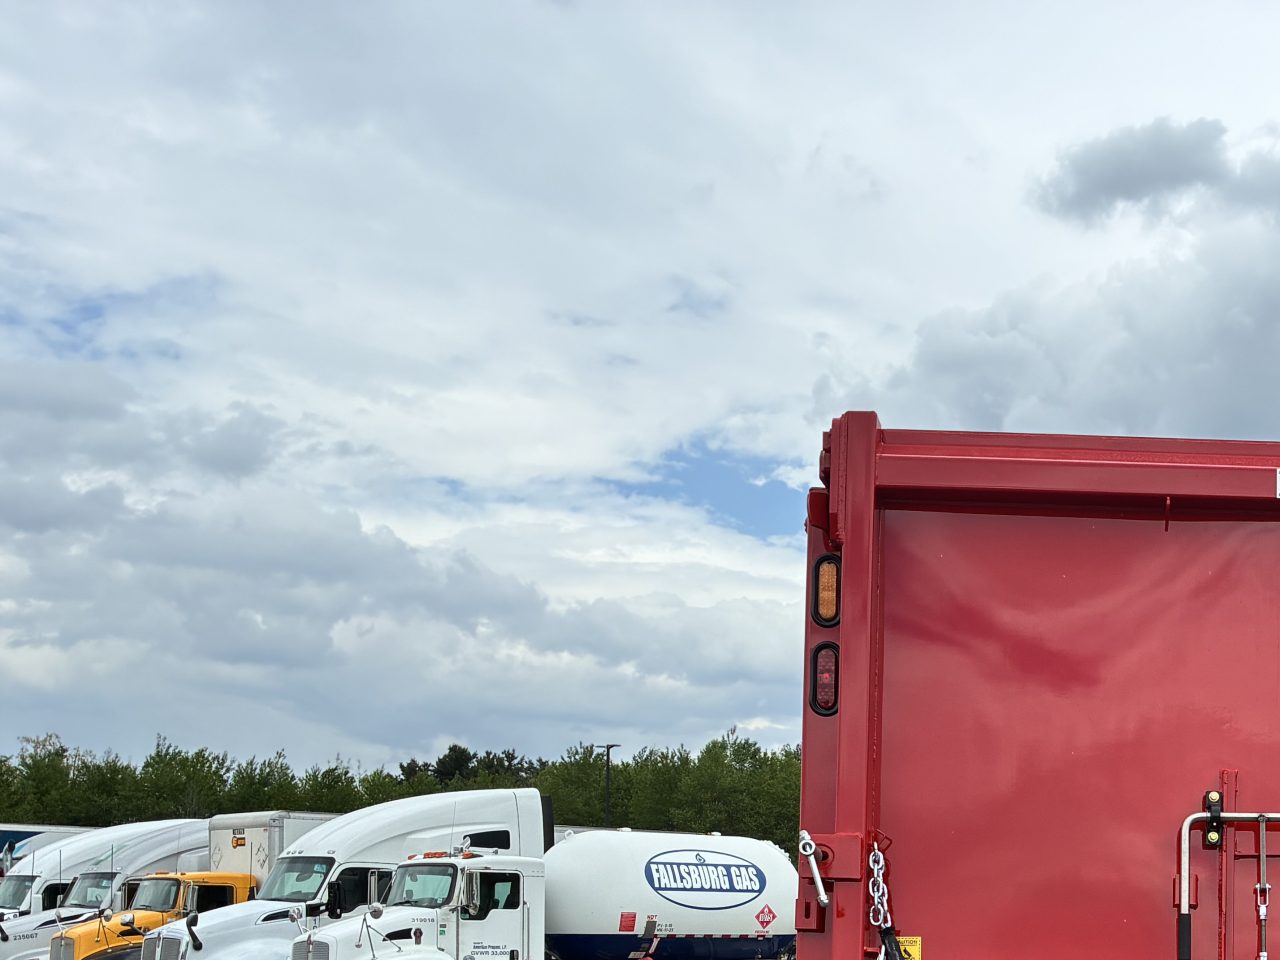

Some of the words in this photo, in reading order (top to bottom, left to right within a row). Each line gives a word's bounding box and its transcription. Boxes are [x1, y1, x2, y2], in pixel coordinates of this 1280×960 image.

[650, 863, 730, 890] FALLSBURG
[730, 866, 760, 891] GAS
[13, 933, 38, 941] 235067
